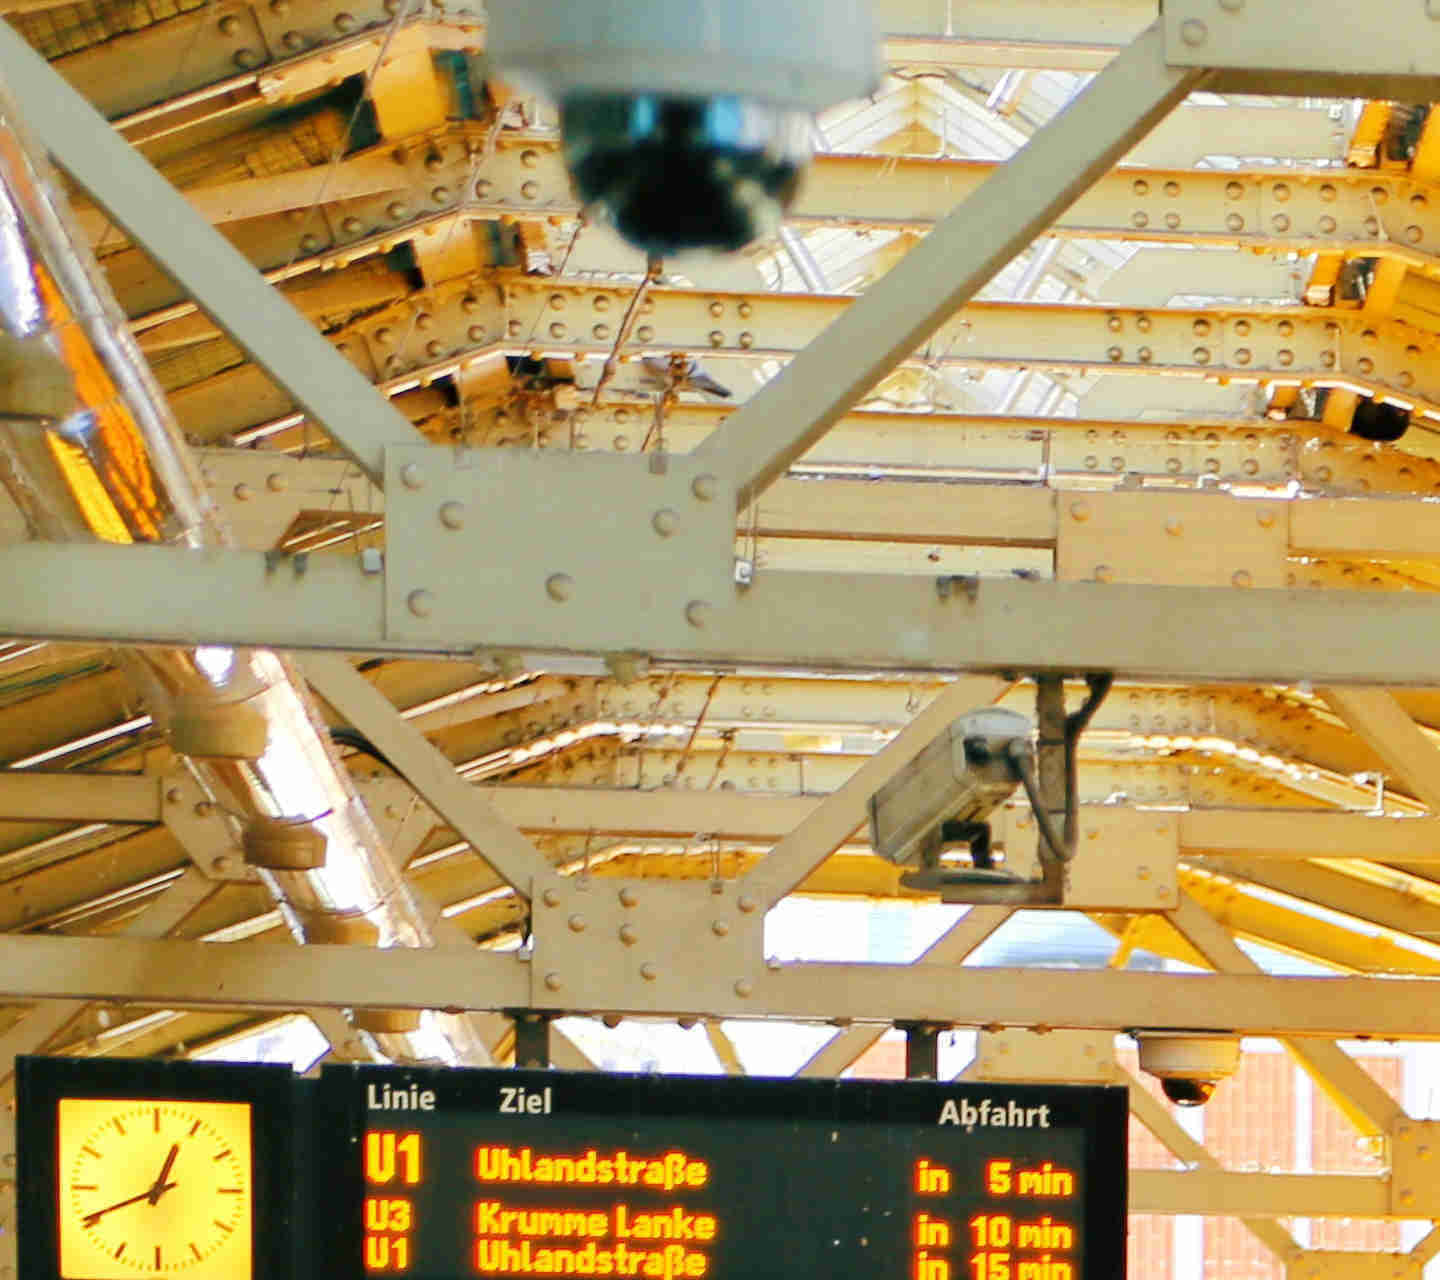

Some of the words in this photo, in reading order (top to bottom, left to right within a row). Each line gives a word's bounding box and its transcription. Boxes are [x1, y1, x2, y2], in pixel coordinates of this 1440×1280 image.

[367, 1083, 436, 1111] Linie
[499, 1087, 552, 1114] Ziel
[938, 1098, 1050, 1128] Abfahrt
[365, 1131, 422, 1184] U1
[477, 1146, 708, 1190] Uhlandstraße
[916, 1159, 951, 1192] in
[988, 1159, 1012, 1194] 5
[1017, 1162, 1074, 1196] min
[365, 1199, 412, 1232] U3
[477, 1201, 609, 1237] Krumme
[614, 1204, 716, 1240] Lanke
[916, 1213, 950, 1246] in
[970, 1215, 1012, 1248] 10
[1016, 1217, 1073, 1249] min
[365, 1236, 410, 1269] U1
[477, 1238, 707, 1280] Uhlandstraße
